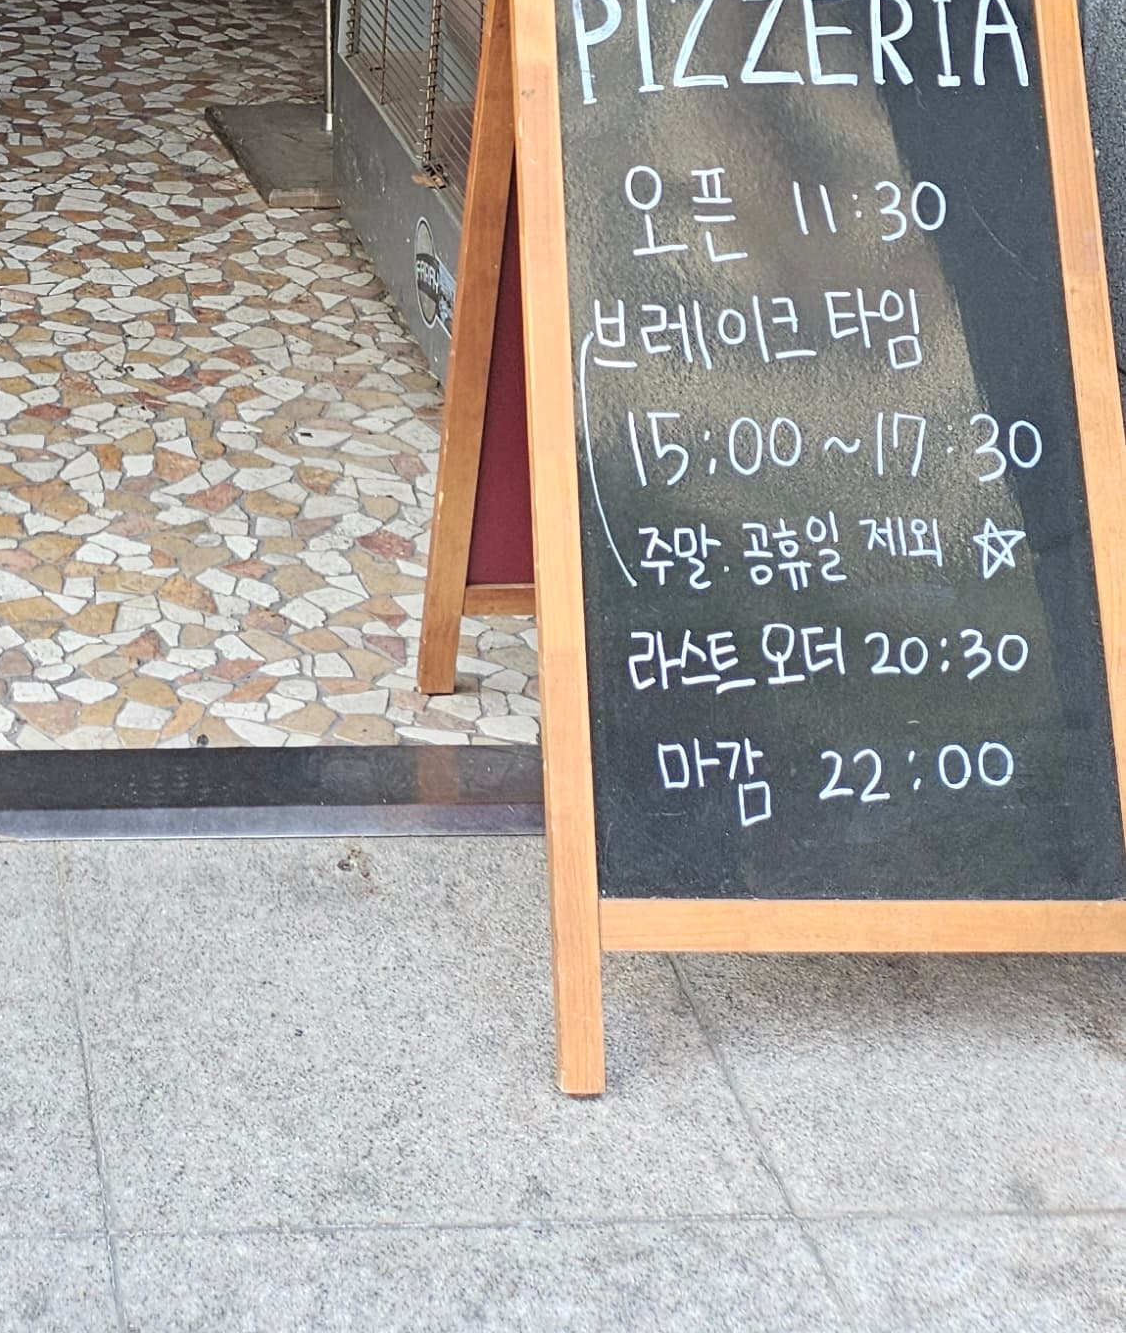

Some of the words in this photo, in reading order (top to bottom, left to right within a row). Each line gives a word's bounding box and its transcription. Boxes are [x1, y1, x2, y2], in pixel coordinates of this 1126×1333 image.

[625, 165, 749, 262] 오픈
[792, 180, 947, 242] 11:30
[592, 295, 817, 369] 브레이크
[825, 288, 924, 370] 타임
[858, 516, 944, 568] 제외
[864, 628, 1030, 680] 20:30
[656, 737, 773, 828] 마감
[818, 741, 1015, 803] 22:00
